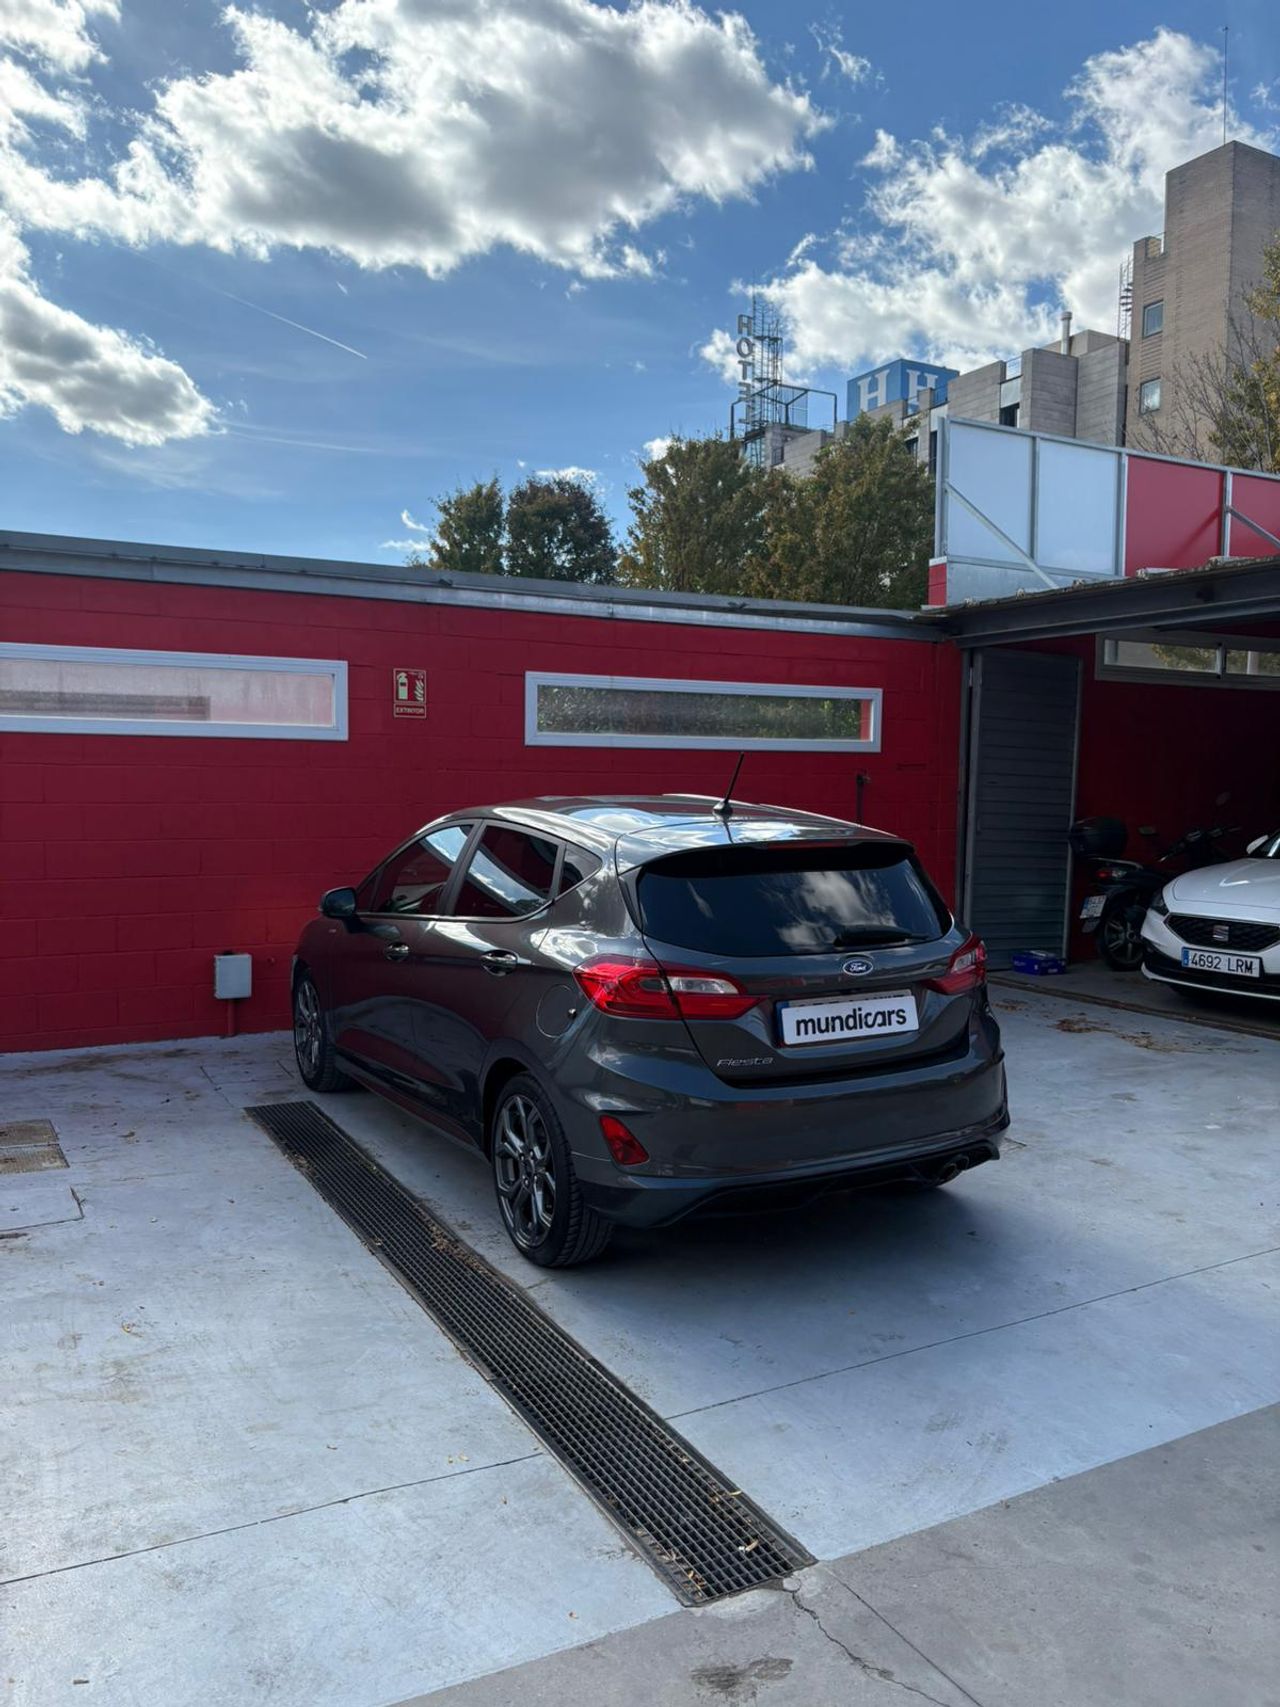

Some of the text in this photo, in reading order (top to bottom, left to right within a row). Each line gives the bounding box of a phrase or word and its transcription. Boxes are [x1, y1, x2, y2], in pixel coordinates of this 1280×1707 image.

[857, 369, 891, 413] H
[1191, 952, 1254, 975] 4692 LRM
[796, 1007, 907, 1036] mundicars
[716, 1057, 774, 1067] Fiesta
